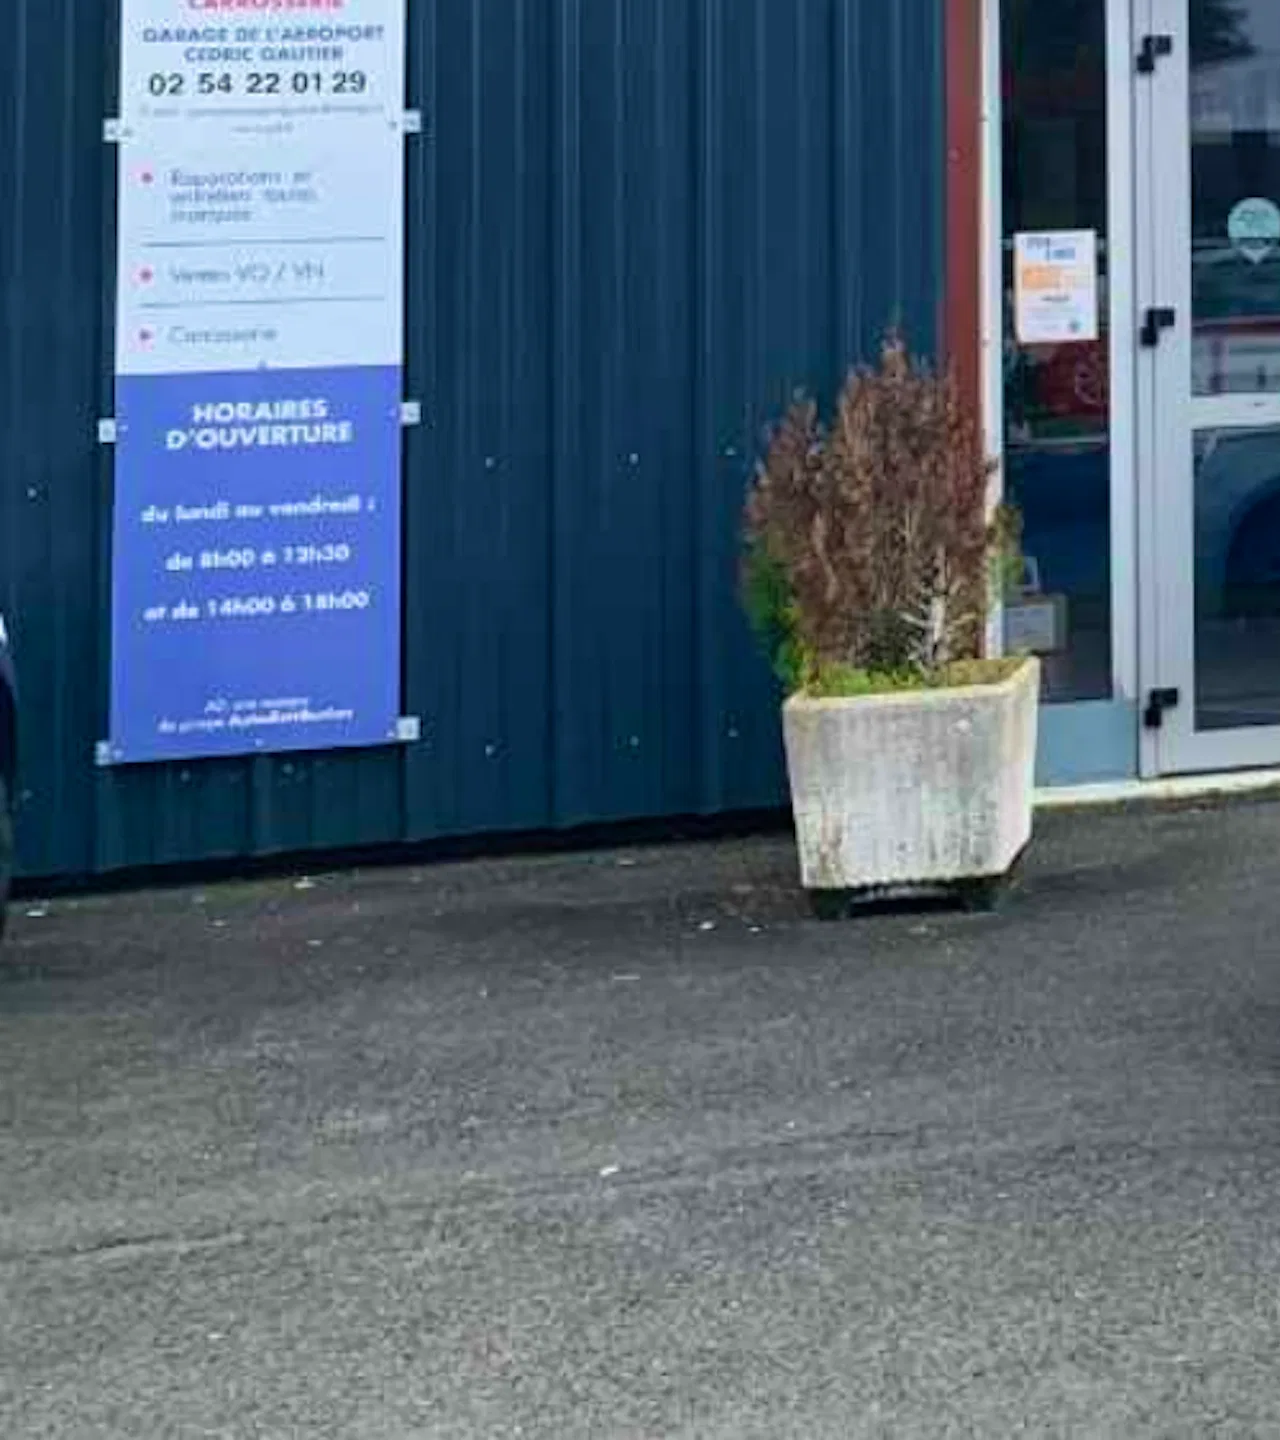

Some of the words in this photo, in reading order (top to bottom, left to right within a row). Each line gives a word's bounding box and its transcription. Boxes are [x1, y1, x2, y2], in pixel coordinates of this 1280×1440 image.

[149, 72, 185, 96] 02
[197, 72, 234, 94] 54
[246, 72, 281, 94] 22
[291, 71, 323, 94] 01
[332, 71, 368, 94] 29
[192, 399, 328, 423] HORAIRES
[166, 421, 354, 449] D'OUVERTURE
